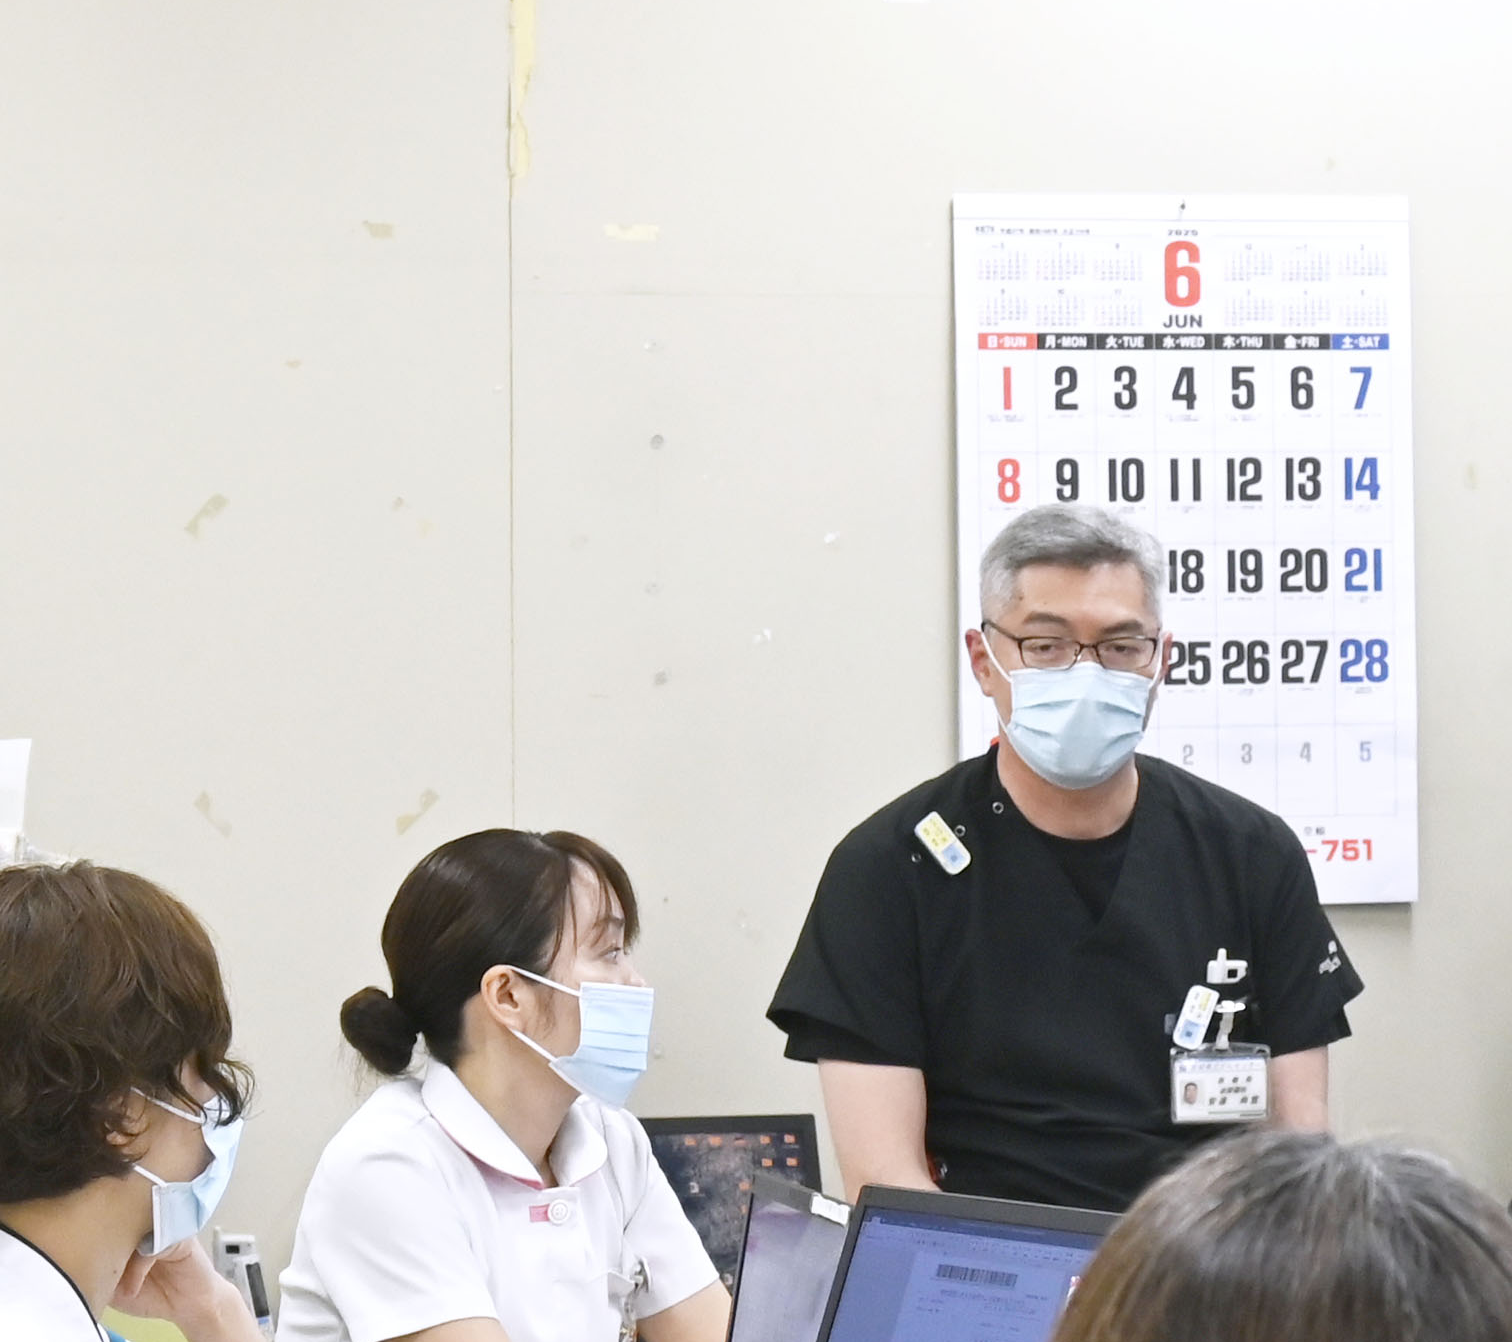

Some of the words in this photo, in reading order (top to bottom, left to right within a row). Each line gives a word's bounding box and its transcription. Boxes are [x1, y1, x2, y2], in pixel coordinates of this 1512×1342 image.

[1164, 240, 1201, 308] 6
[1163, 315, 1202, 328] JUN
[1004, 367, 1011, 410] 1
[1055, 366, 1078, 410] 2
[1114, 366, 1137, 410] 3
[1172, 367, 1196, 410] 4
[1232, 366, 1255, 410] 5
[1291, 366, 1313, 410] 6
[1350, 367, 1372, 409] 7
[998, 459, 1020, 503] 8
[1056, 458, 1079, 503] 9
[1108, 458, 1144, 502] 10
[1170, 458, 1201, 502] 11
[1227, 457, 1262, 502] 12
[1286, 457, 1321, 501] 13
[1345, 457, 1380, 500] 14
[1168, 549, 1205, 594] 18
[1227, 549, 1263, 593] 19
[1280, 548, 1328, 593] 20
[1345, 548, 1382, 592] 21
[1164, 640, 1211, 685] 25
[1222, 640, 1270, 684] 26
[1281, 640, 1328, 684] 27
[1340, 639, 1388, 683] 28
[1182, 744, 1194, 767] 2
[1242, 744, 1252, 763] 3
[1300, 743, 1310, 761] 4
[1360, 741, 1371, 761] 5
